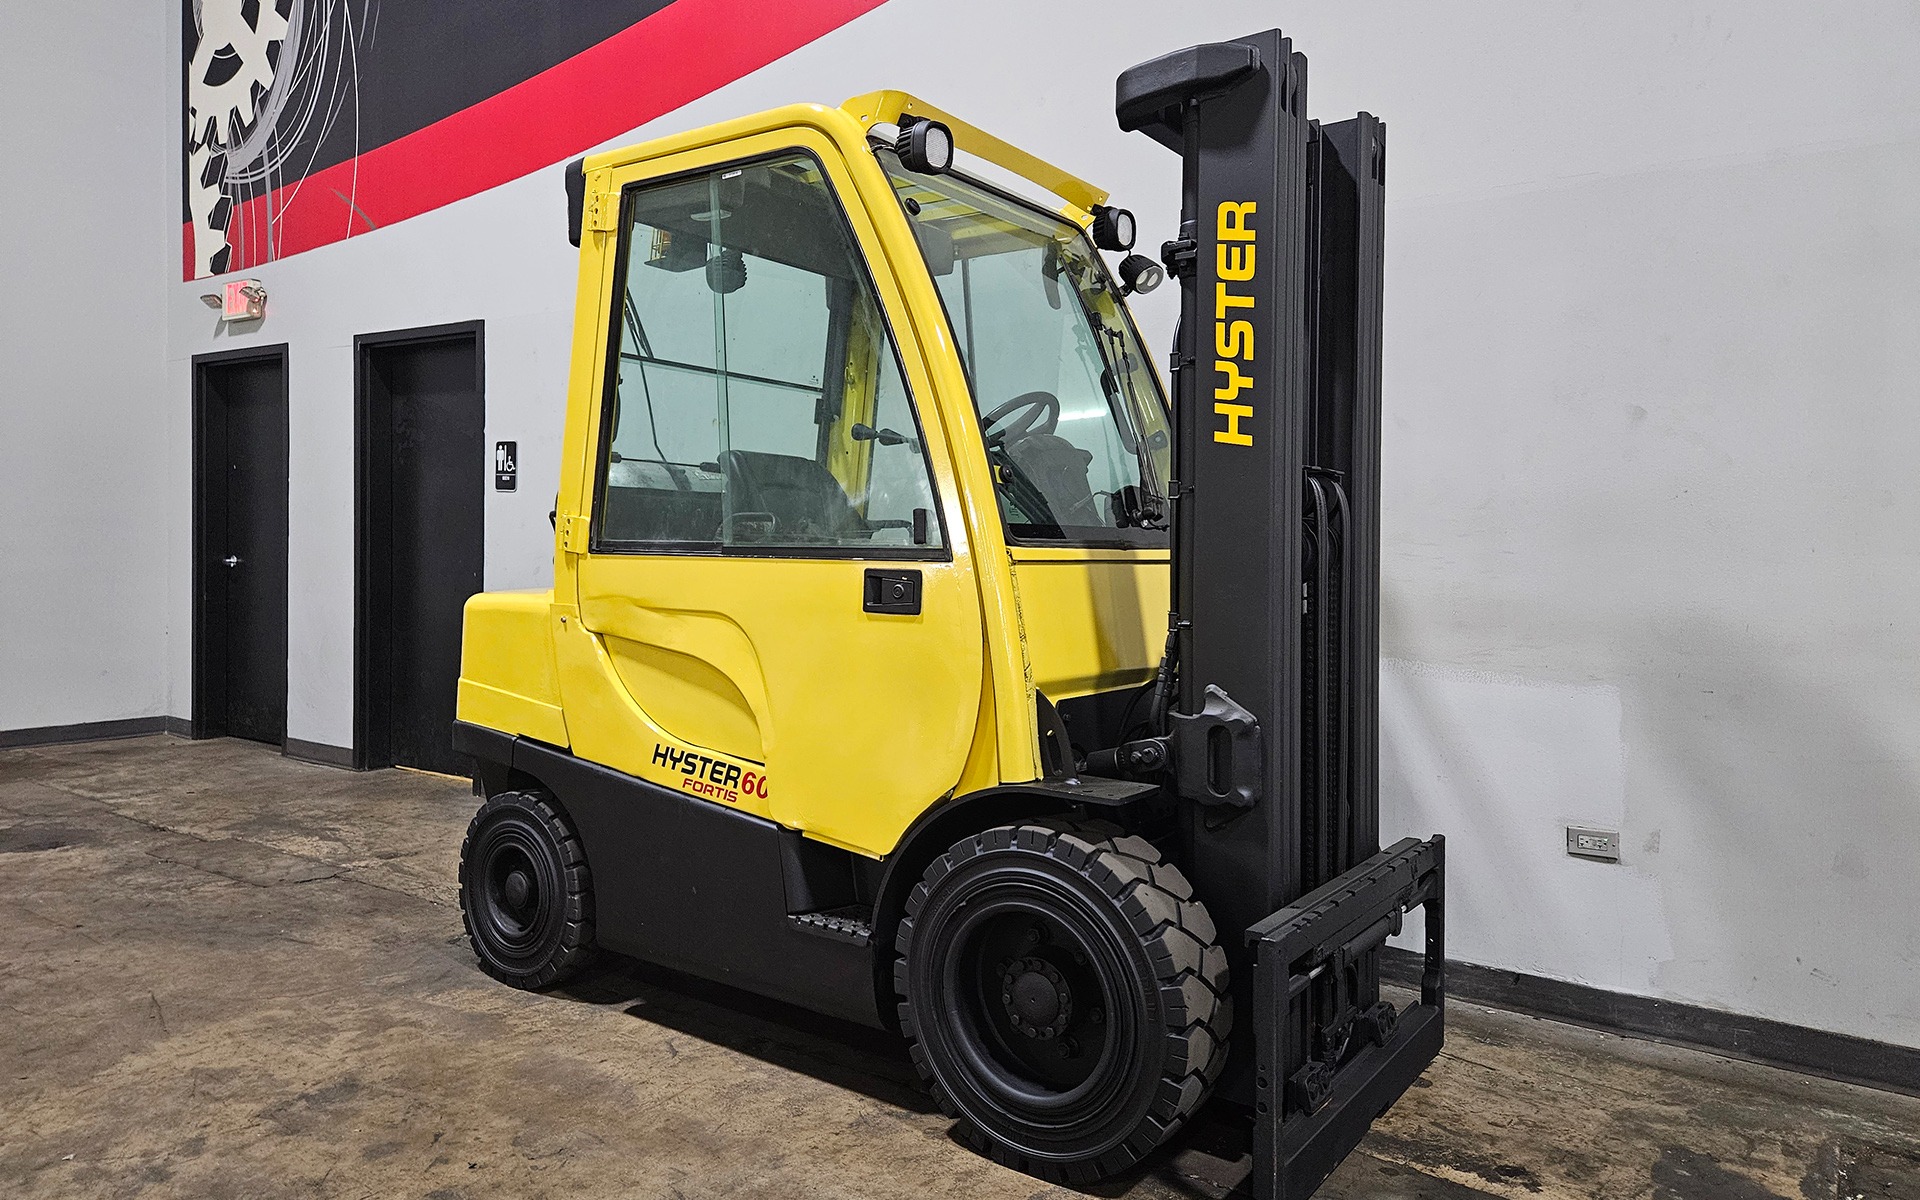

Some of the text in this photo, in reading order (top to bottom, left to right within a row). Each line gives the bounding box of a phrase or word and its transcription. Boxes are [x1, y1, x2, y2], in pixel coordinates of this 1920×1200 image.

[1213, 200, 1257, 447] HYSTER
[652, 743, 742, 789] HYSTER
[682, 777, 739, 803] FORTIS
